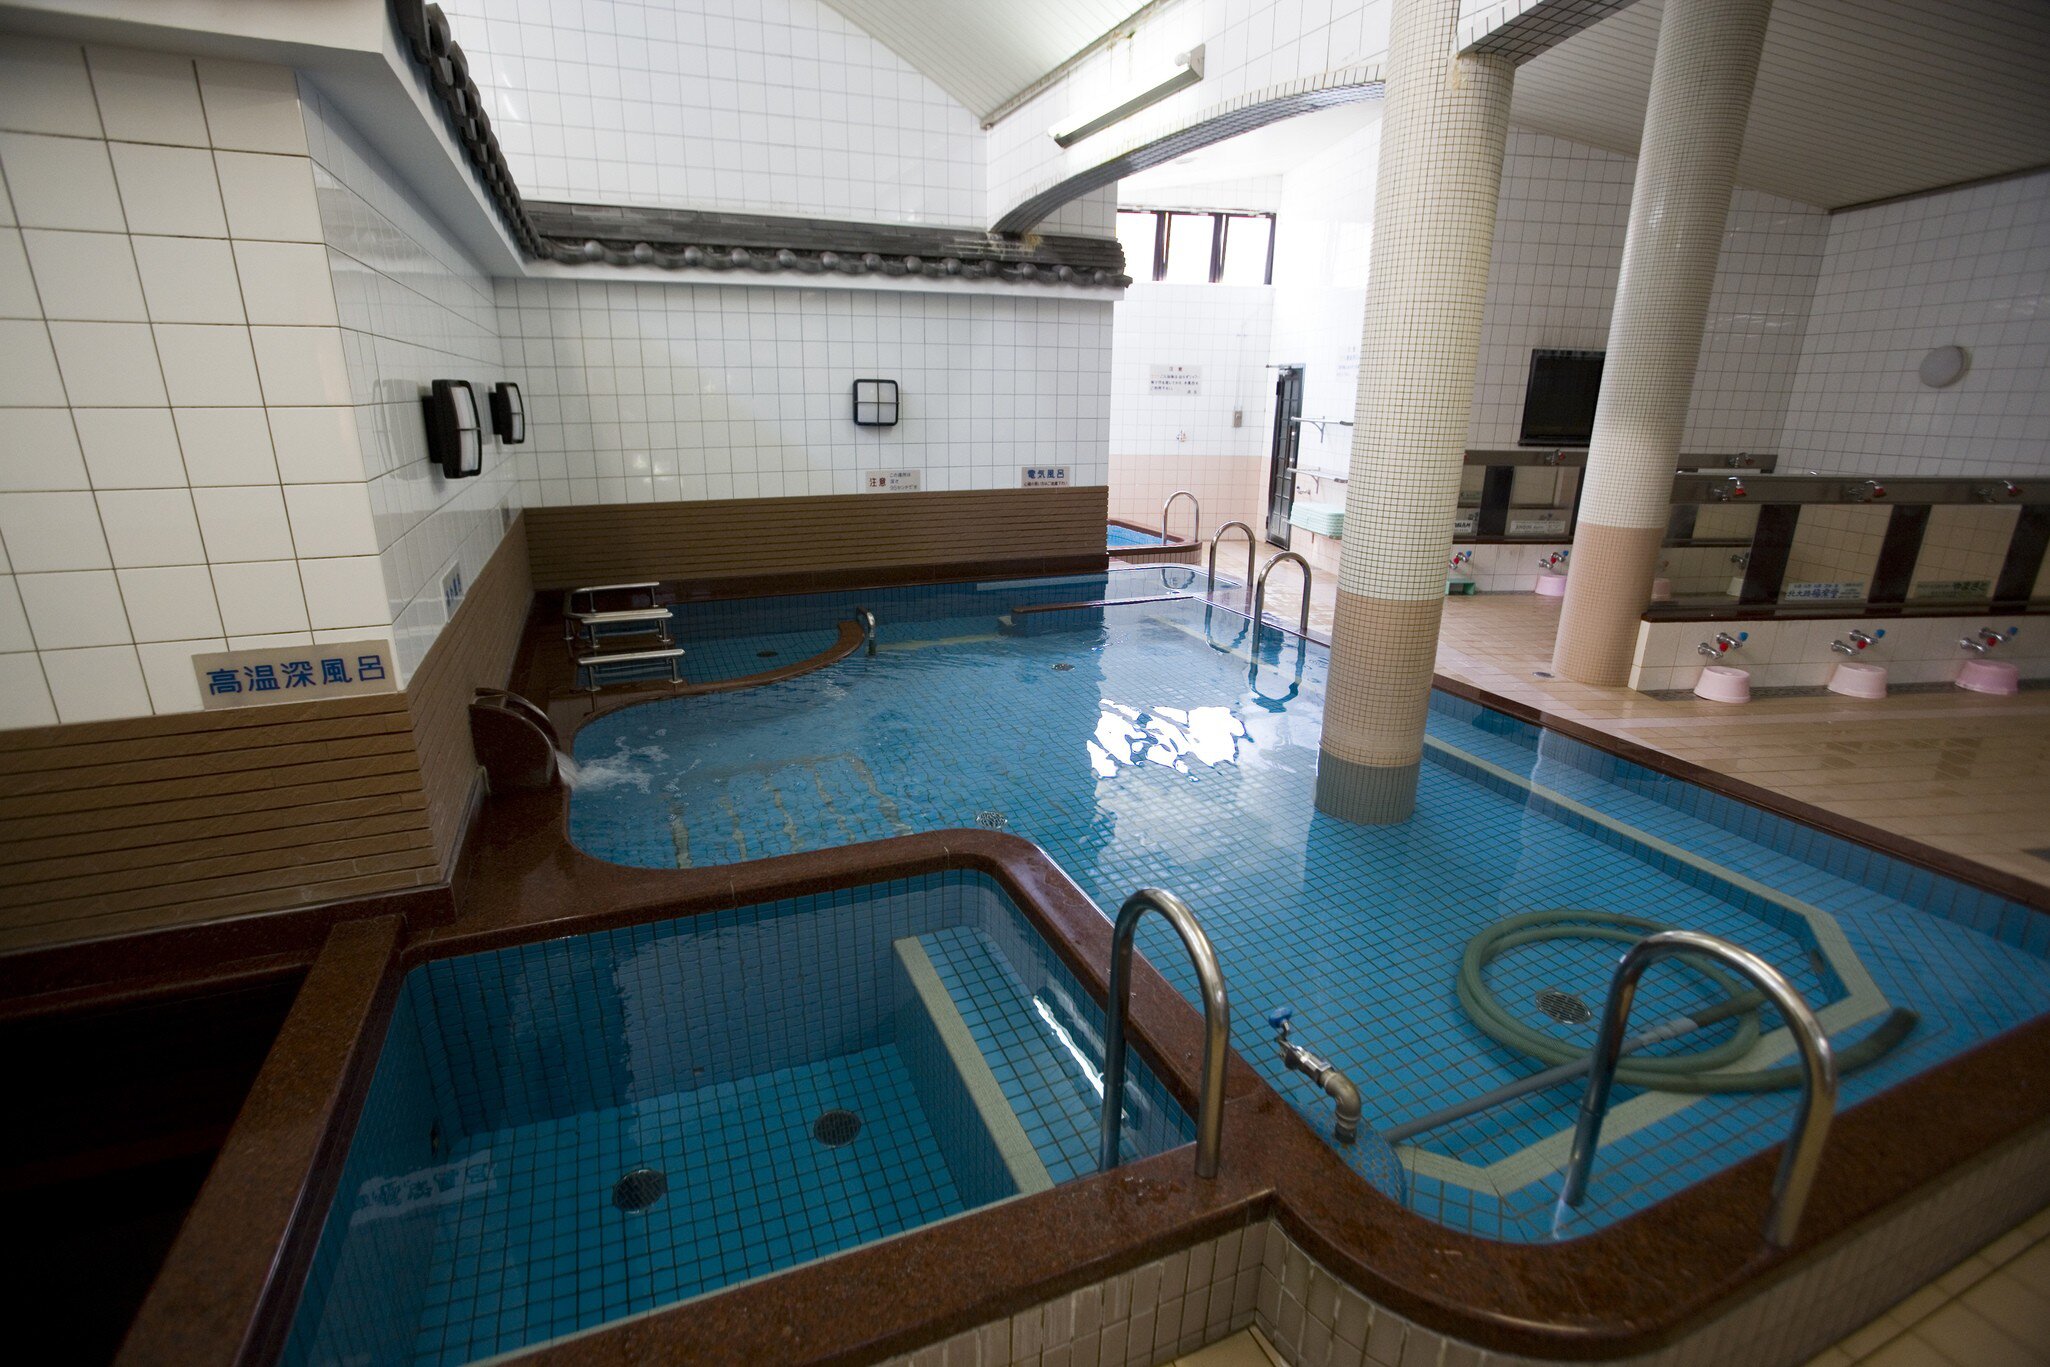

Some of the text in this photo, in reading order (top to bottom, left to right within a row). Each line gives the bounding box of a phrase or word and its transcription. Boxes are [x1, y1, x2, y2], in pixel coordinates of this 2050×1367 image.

[1027, 469, 1064, 479] 電気風呂
[870, 477, 886, 487] 注意
[206, 655, 386, 696] 高温深風呂
